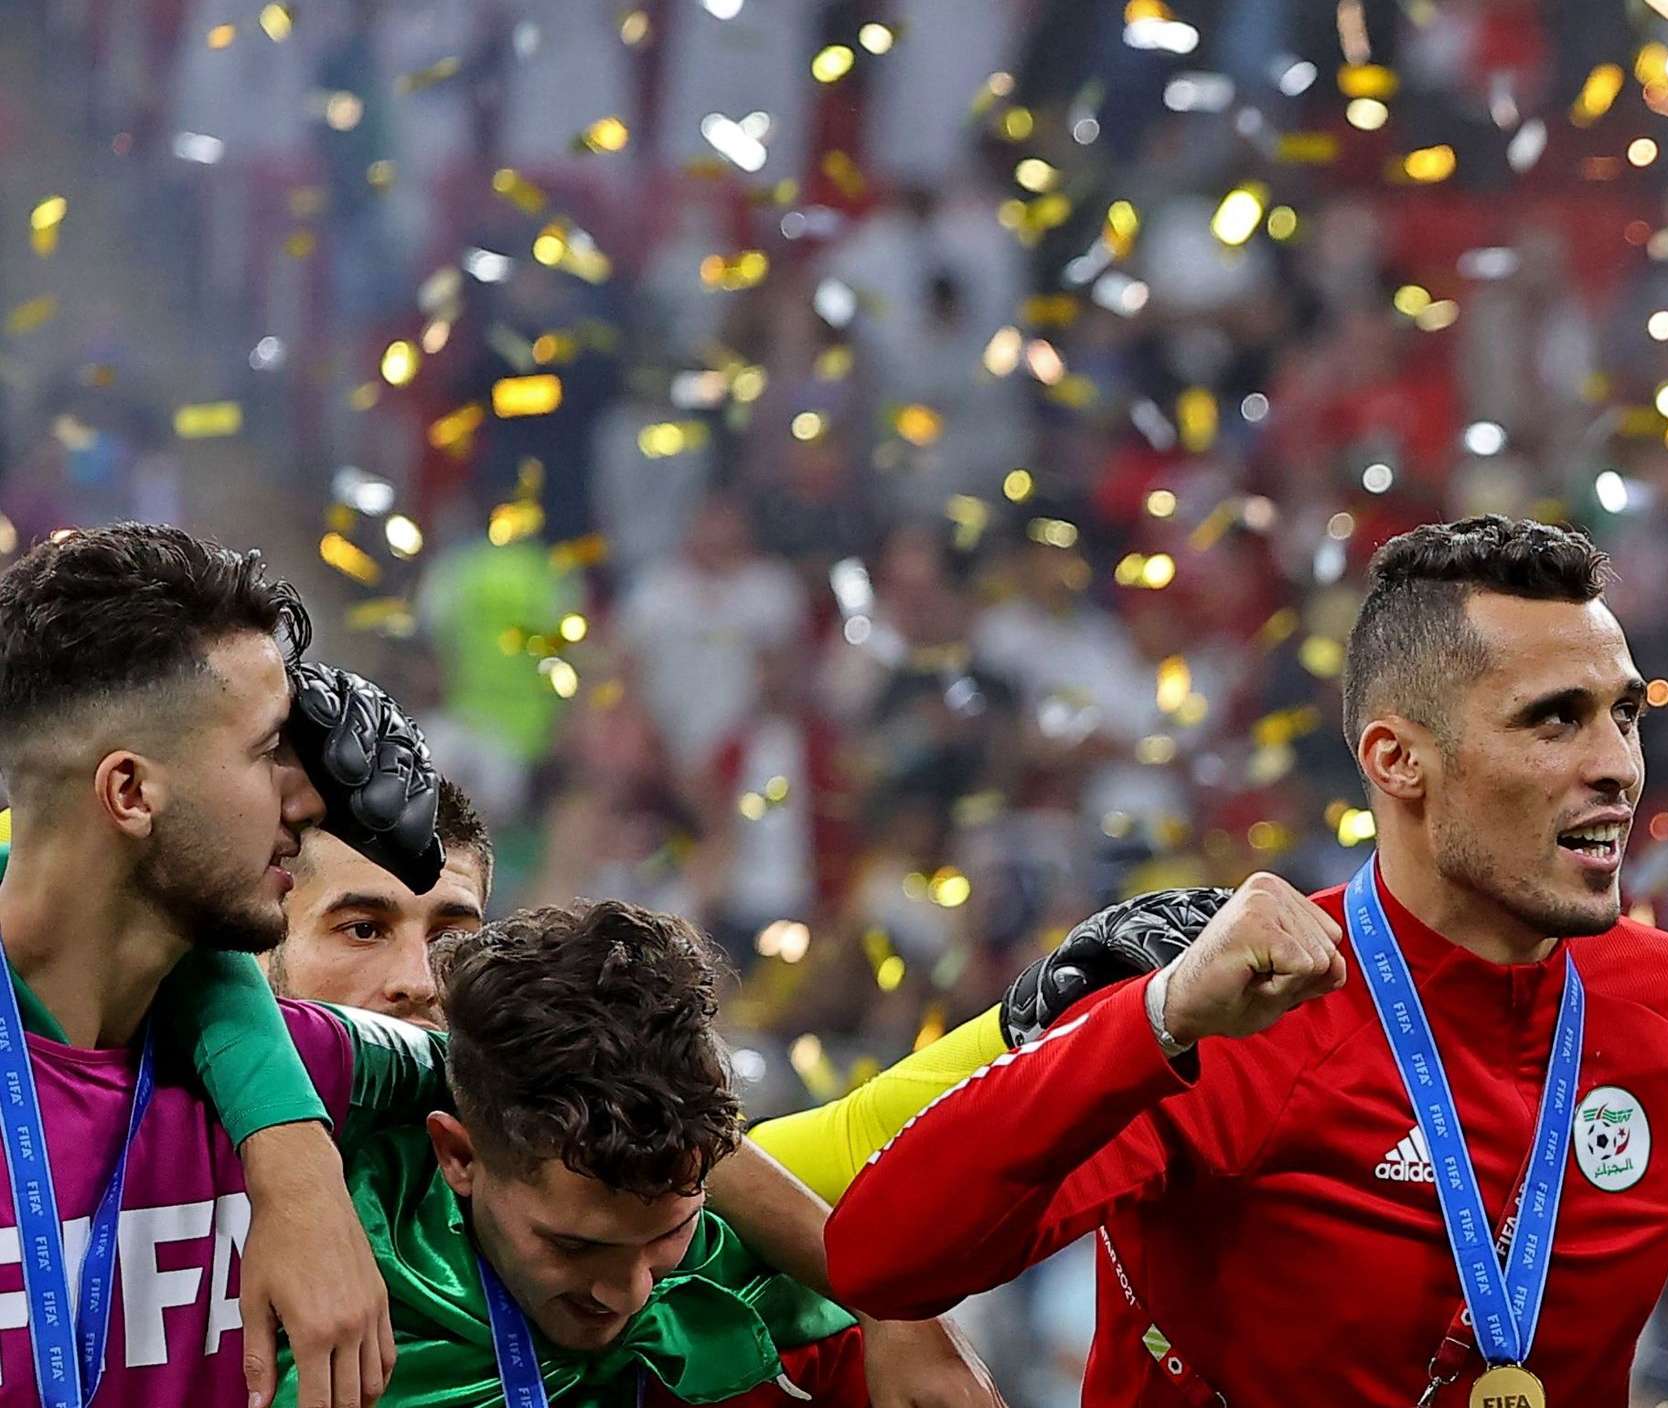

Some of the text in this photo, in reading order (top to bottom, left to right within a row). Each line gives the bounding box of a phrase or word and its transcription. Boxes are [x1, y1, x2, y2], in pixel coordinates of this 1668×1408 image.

[1358, 906, 1376, 936] FIFA
[1374, 952, 1396, 984] FIFA
[1393, 1002, 1414, 1034] FIFA
[1563, 1027, 1574, 1063] FIFA
[1411, 1053, 1433, 1086] FIFA
[7, 1071, 23, 1105] FIFA
[1554, 1078, 1567, 1114] FIFA
[1429, 1104, 1448, 1138] FIFA
[18, 1126, 33, 1160] FIFA
[1545, 1130, 1558, 1167] FIFA
[1375, 1161, 1435, 1182] adida
[1444, 1156, 1464, 1190] FIFA
[28, 1181, 43, 1215] FIFA
[1533, 1182, 1548, 1217] FIFA
[1458, 1208, 1477, 1243] FIFA
[35, 1236, 50, 1270] FIFA
[1523, 1234, 1538, 1270] FIFA
[1472, 1262, 1492, 1296] FIFA
[43, 1291, 59, 1325] FIFA
[1487, 1313, 1507, 1348] FIFA
[50, 1347, 64, 1381] FIFA
